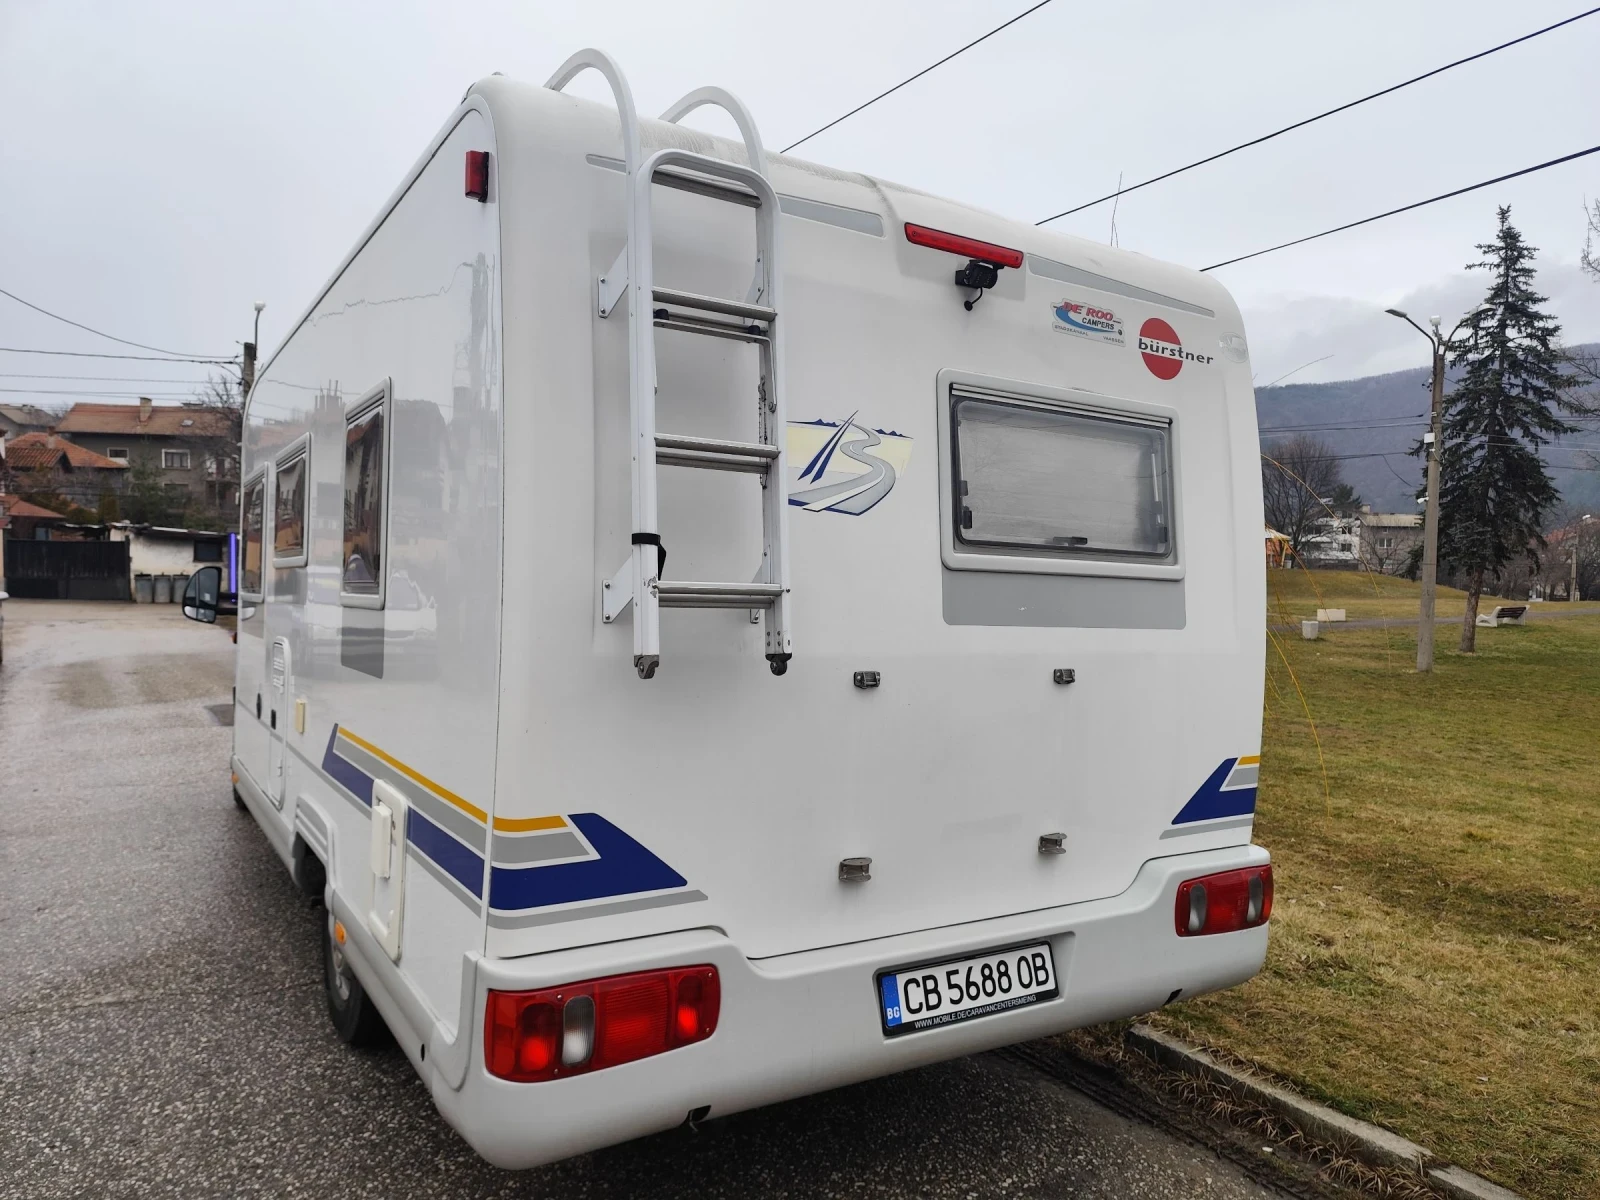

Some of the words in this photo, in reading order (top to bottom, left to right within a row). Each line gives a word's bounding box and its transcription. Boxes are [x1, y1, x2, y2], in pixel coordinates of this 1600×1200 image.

[1062, 301, 1084, 314] DE
[1086, 307, 1114, 321] ROO
[1082, 317, 1115, 330] CAMPERS
[1138, 337, 1214, 365] bürstner
[903, 974, 943, 1015] CB
[945, 959, 1013, 1006] 5688
[1016, 952, 1050, 990] OB
[886, 1006, 900, 1020] BG
